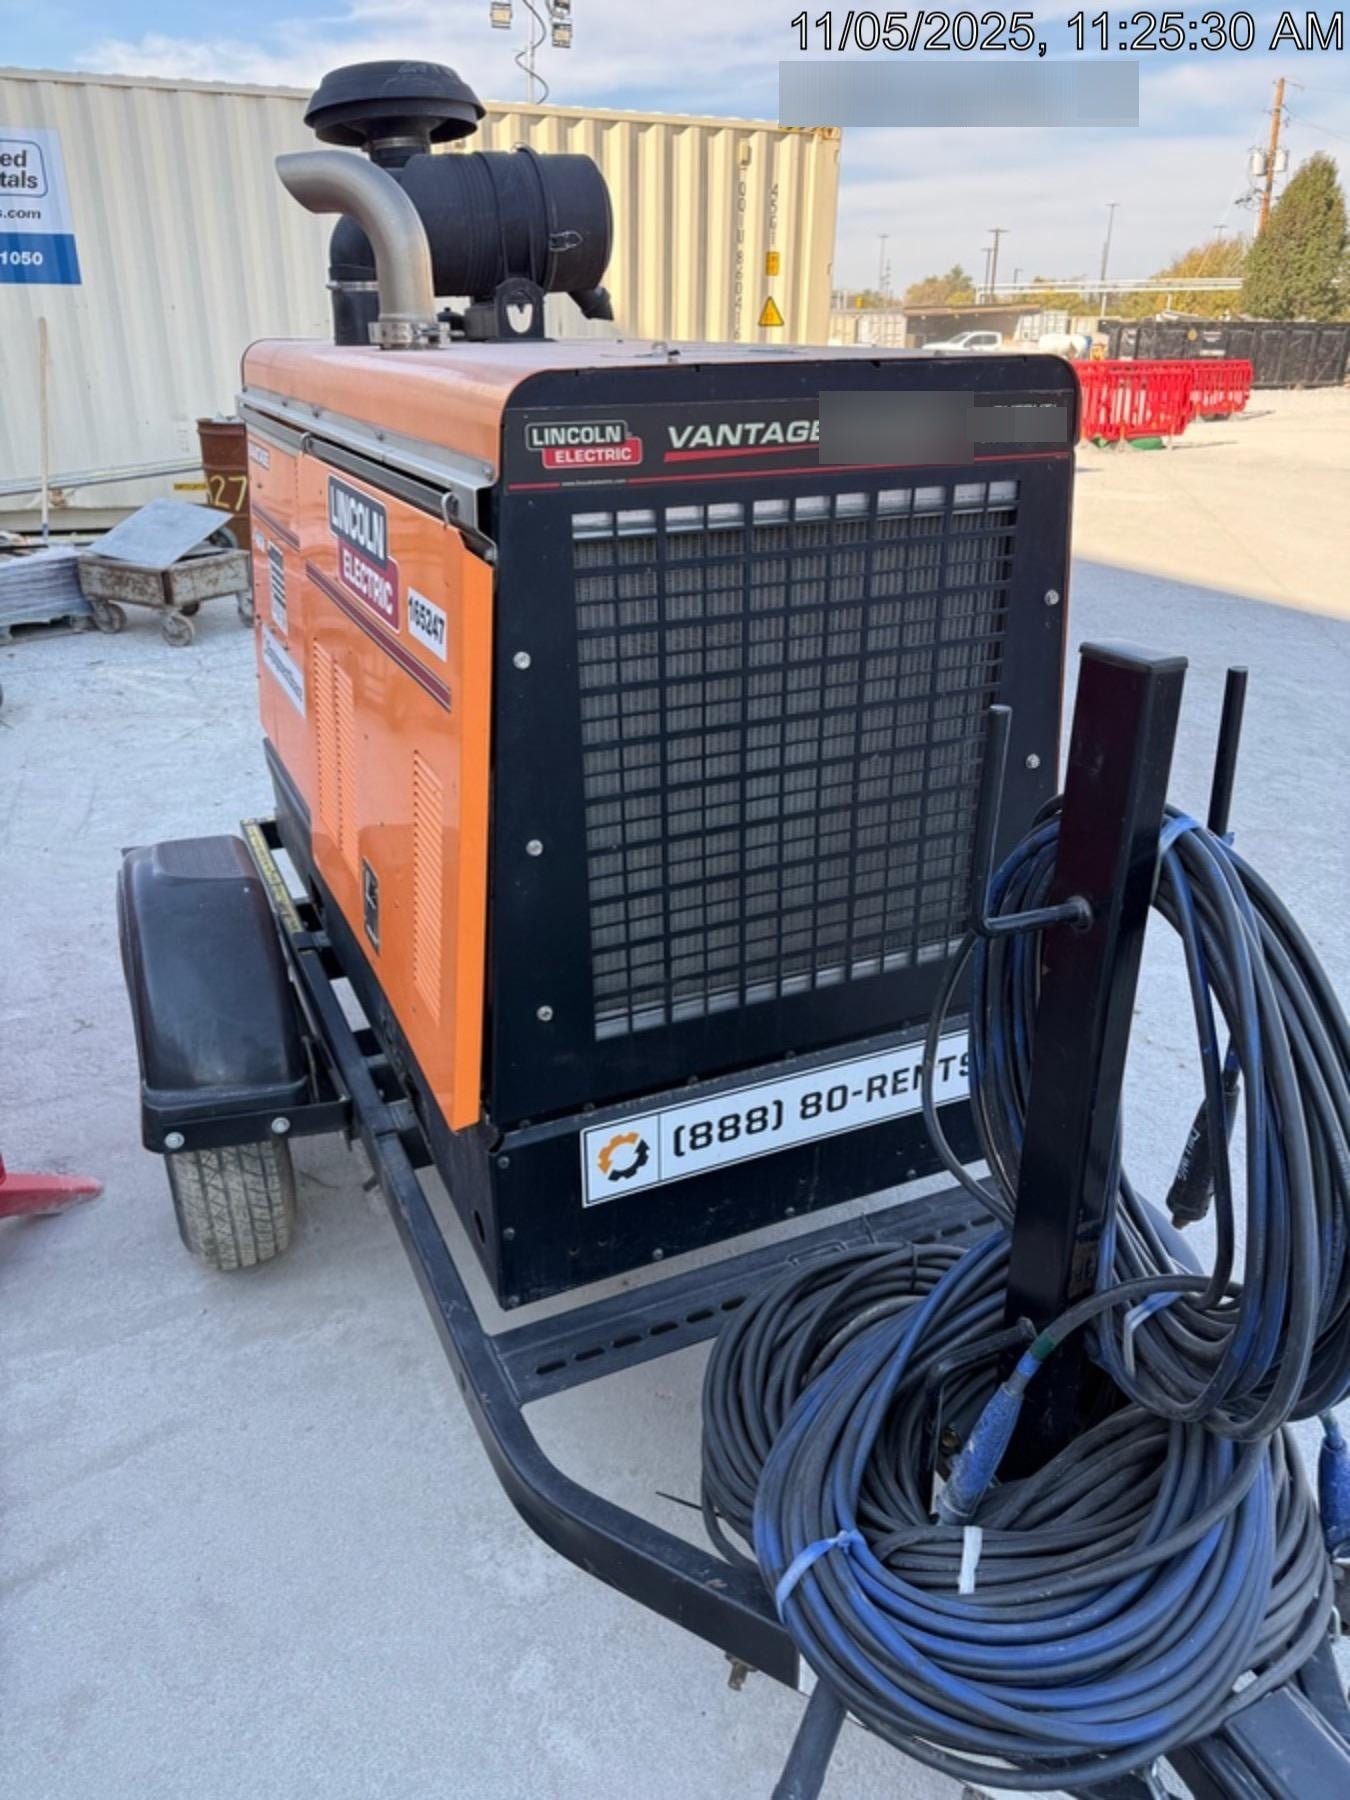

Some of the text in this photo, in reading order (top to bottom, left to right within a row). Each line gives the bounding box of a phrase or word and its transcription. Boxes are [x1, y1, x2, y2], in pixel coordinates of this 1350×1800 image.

[531, 425, 621, 446] LINCOLN
[555, 448, 633, 463] ELECTRIC
[330, 484, 384, 561] LINCOLN
[343, 549, 393, 615] ELECTRIC
[673, 1099, 783, 1157] (888)
